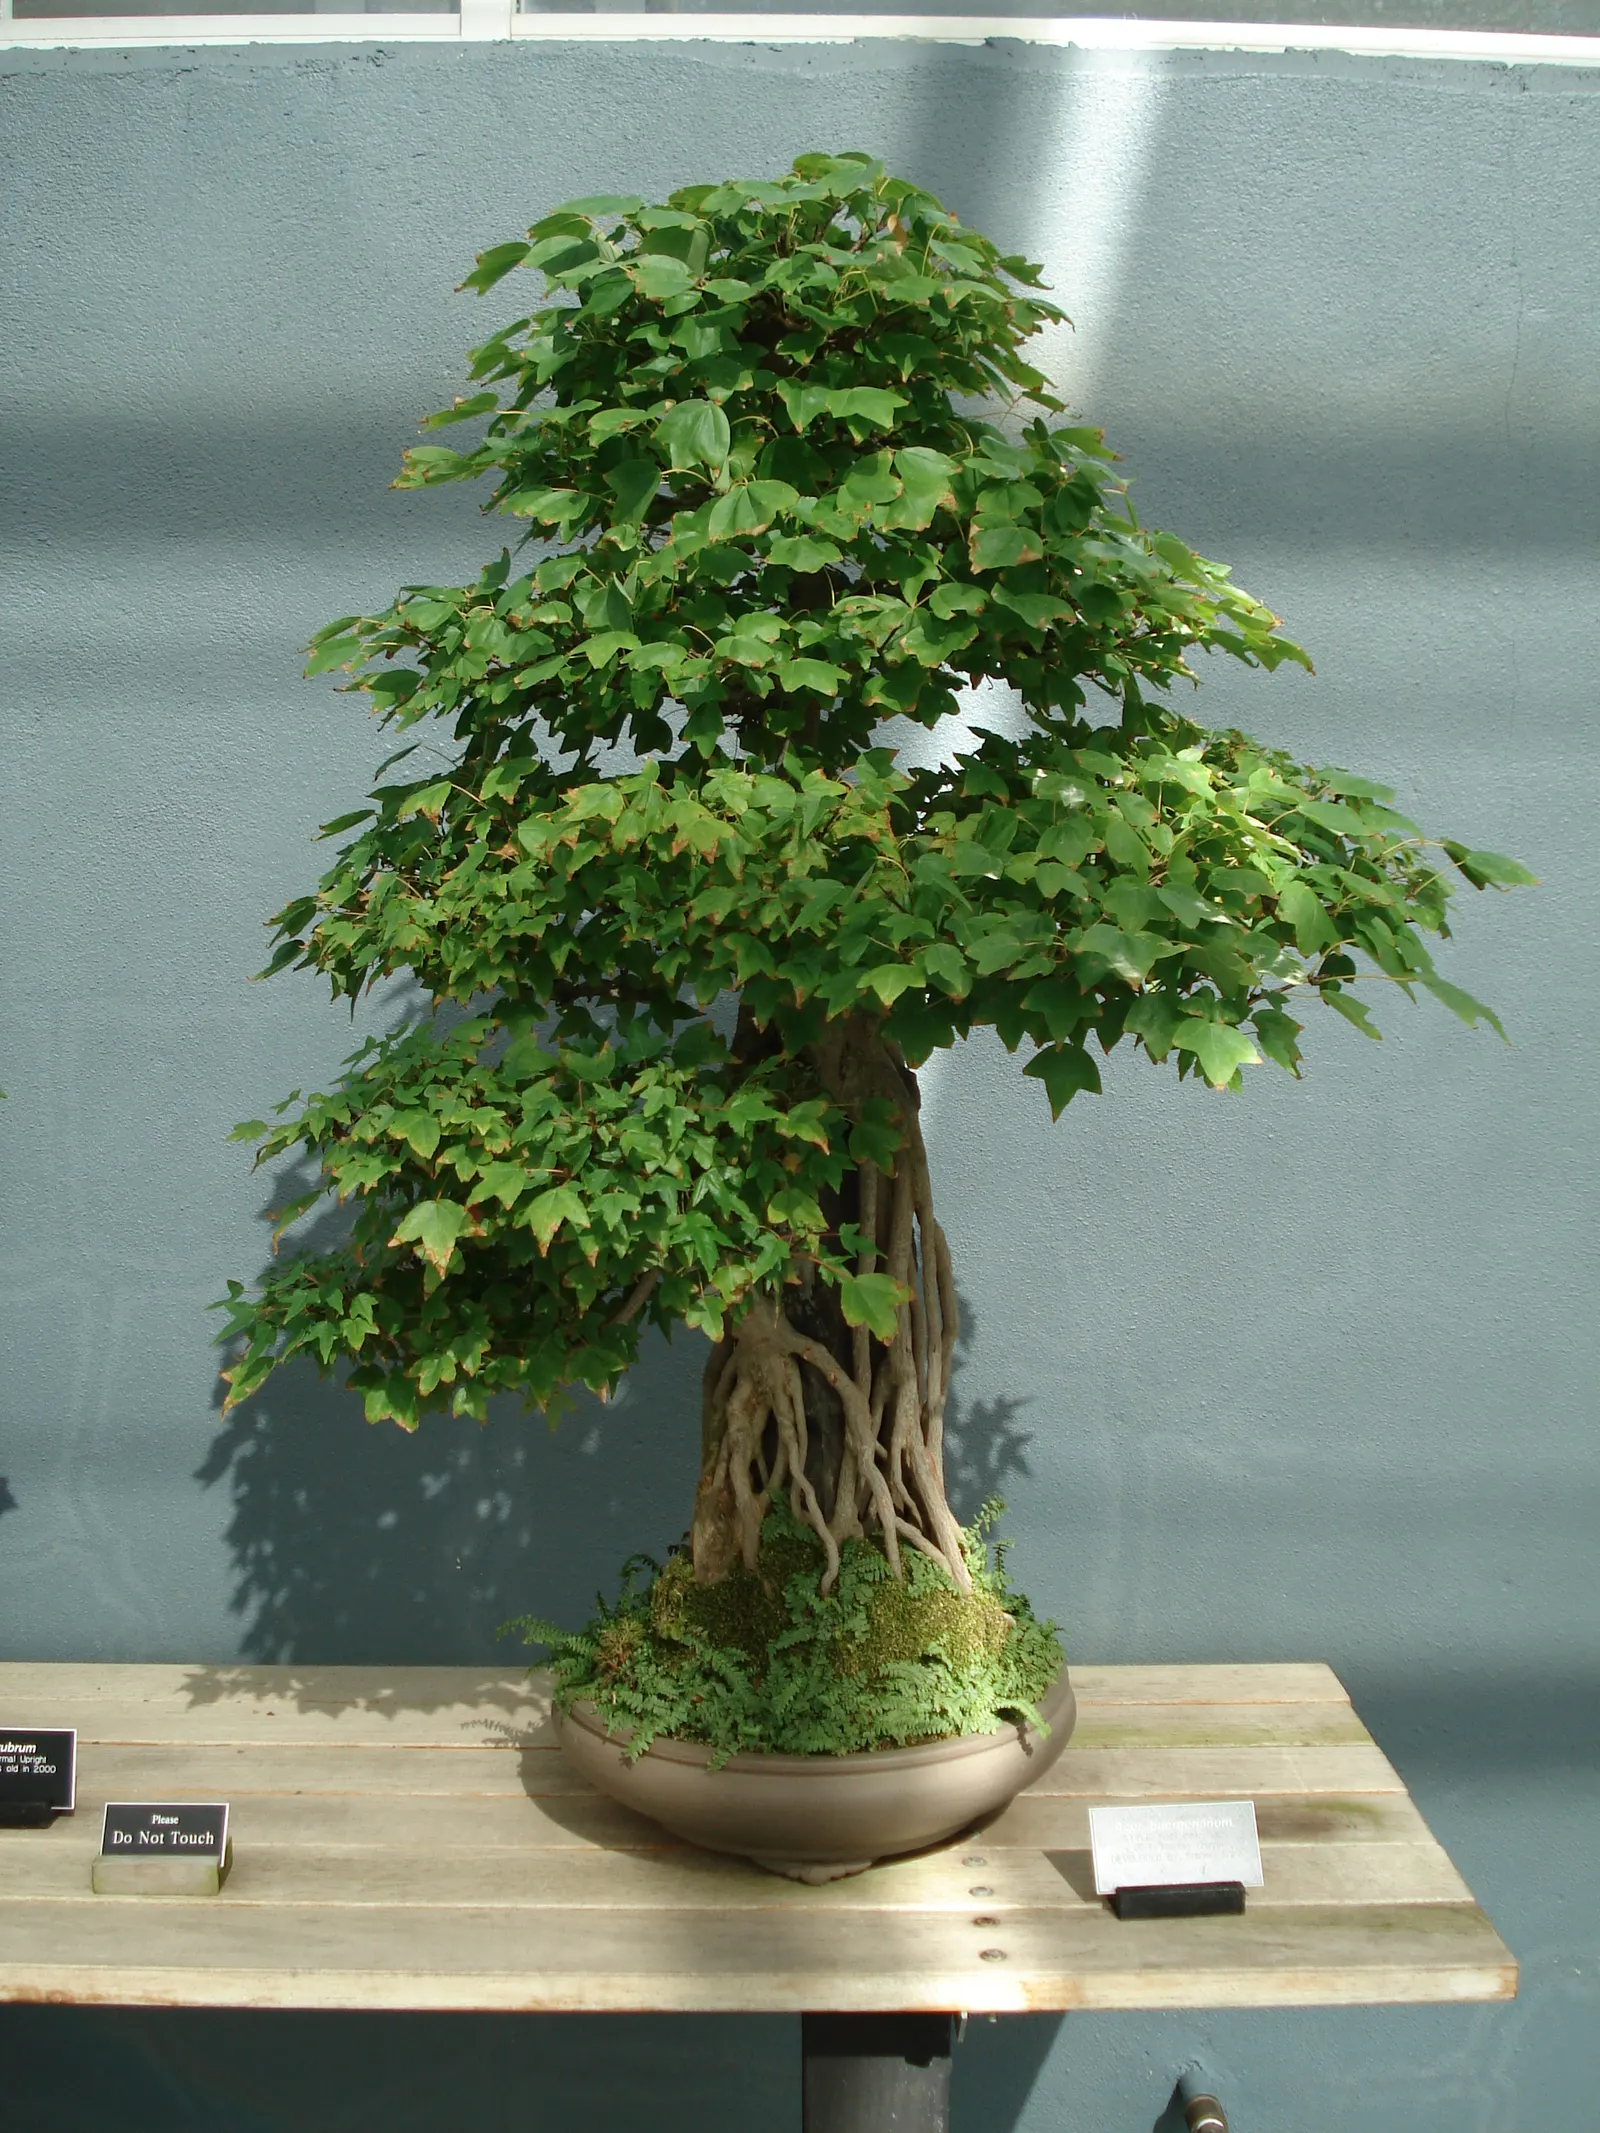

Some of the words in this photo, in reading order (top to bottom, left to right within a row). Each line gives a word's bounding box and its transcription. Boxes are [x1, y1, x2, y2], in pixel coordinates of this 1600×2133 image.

[19, 1755, 47, 1765] Upright
[6, 1764, 19, 1773] old
[22, 1764, 30, 1773] in
[33, 1764, 57, 1774] 2000
[151, 1814, 179, 1825] Please
[113, 1831, 133, 1844] Do
[138, 1831, 165, 1844] Not
[170, 1831, 215, 1845] Touch
